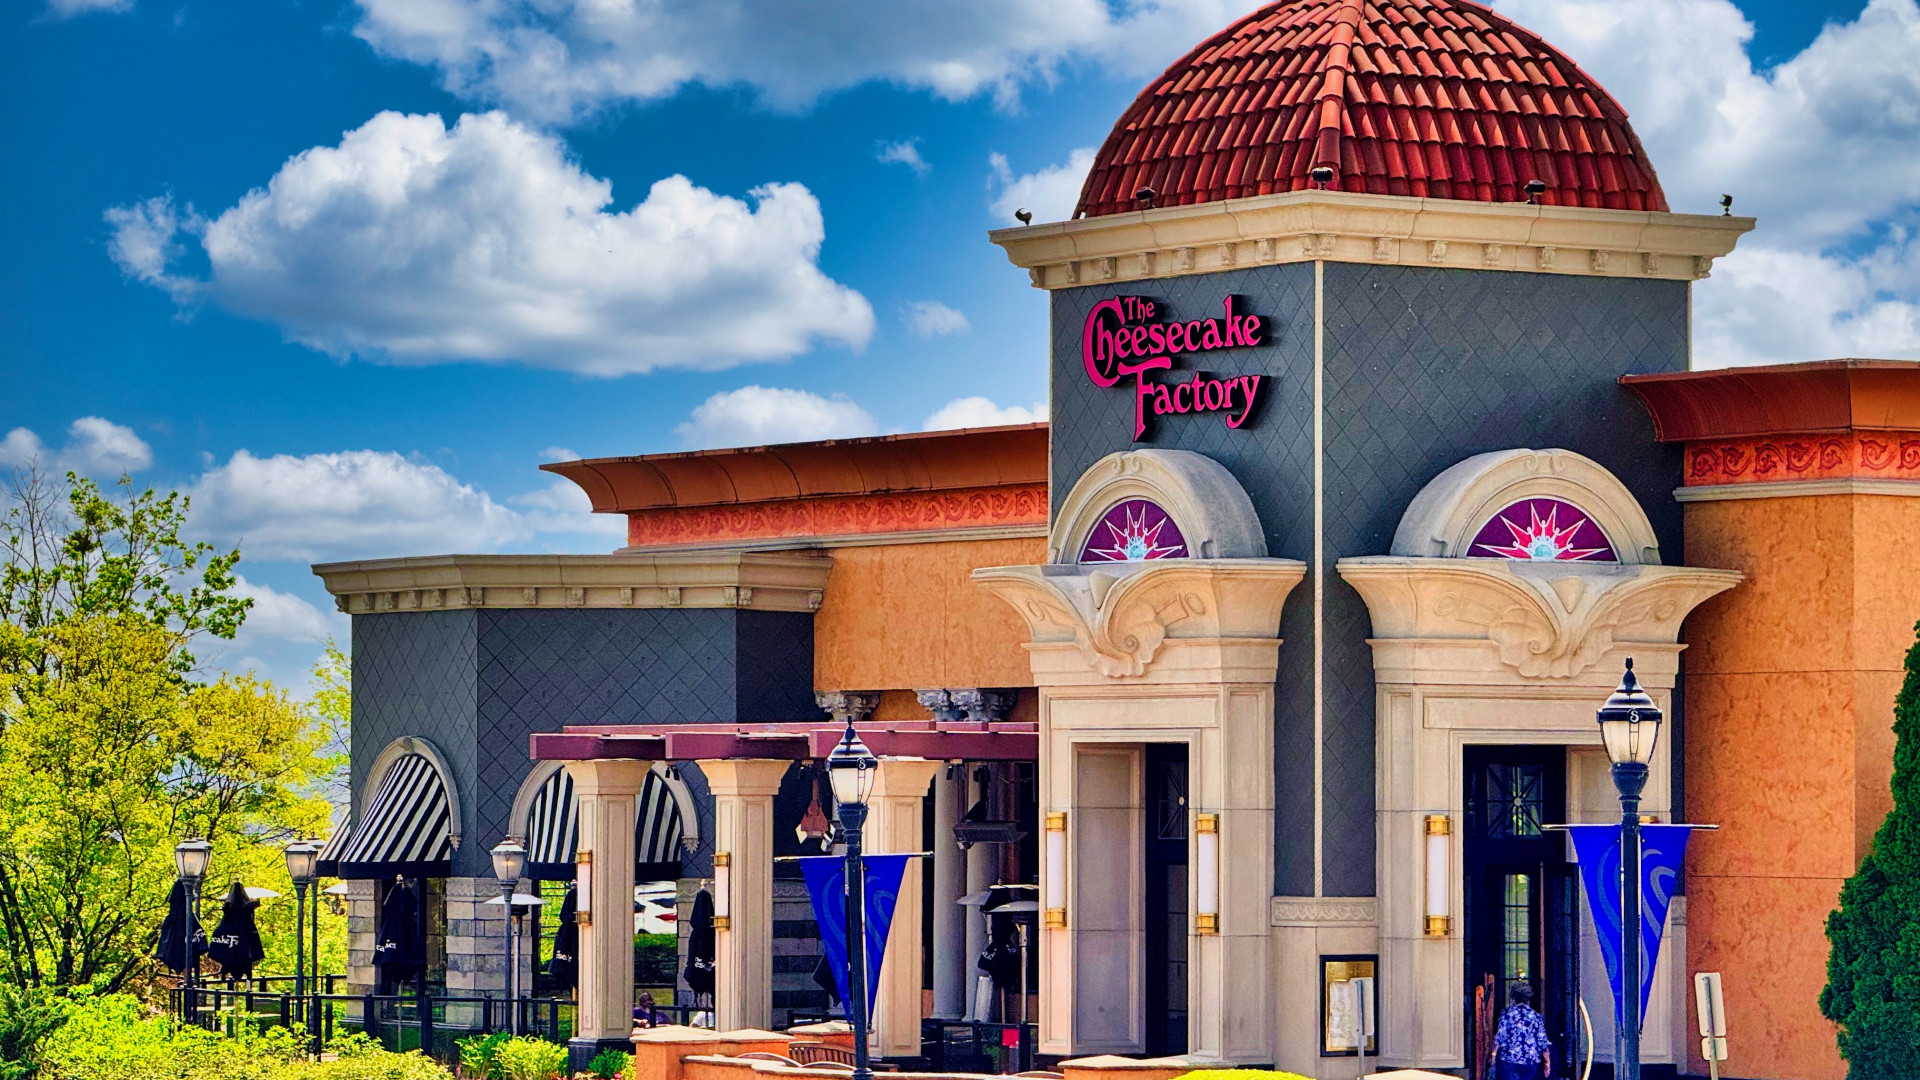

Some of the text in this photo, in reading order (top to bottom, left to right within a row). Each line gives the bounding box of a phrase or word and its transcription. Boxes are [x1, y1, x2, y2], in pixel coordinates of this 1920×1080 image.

[1083, 294, 1262, 388] Cheesecake
[1124, 296, 1155, 323] The
[1117, 356, 1261, 442] Factory
